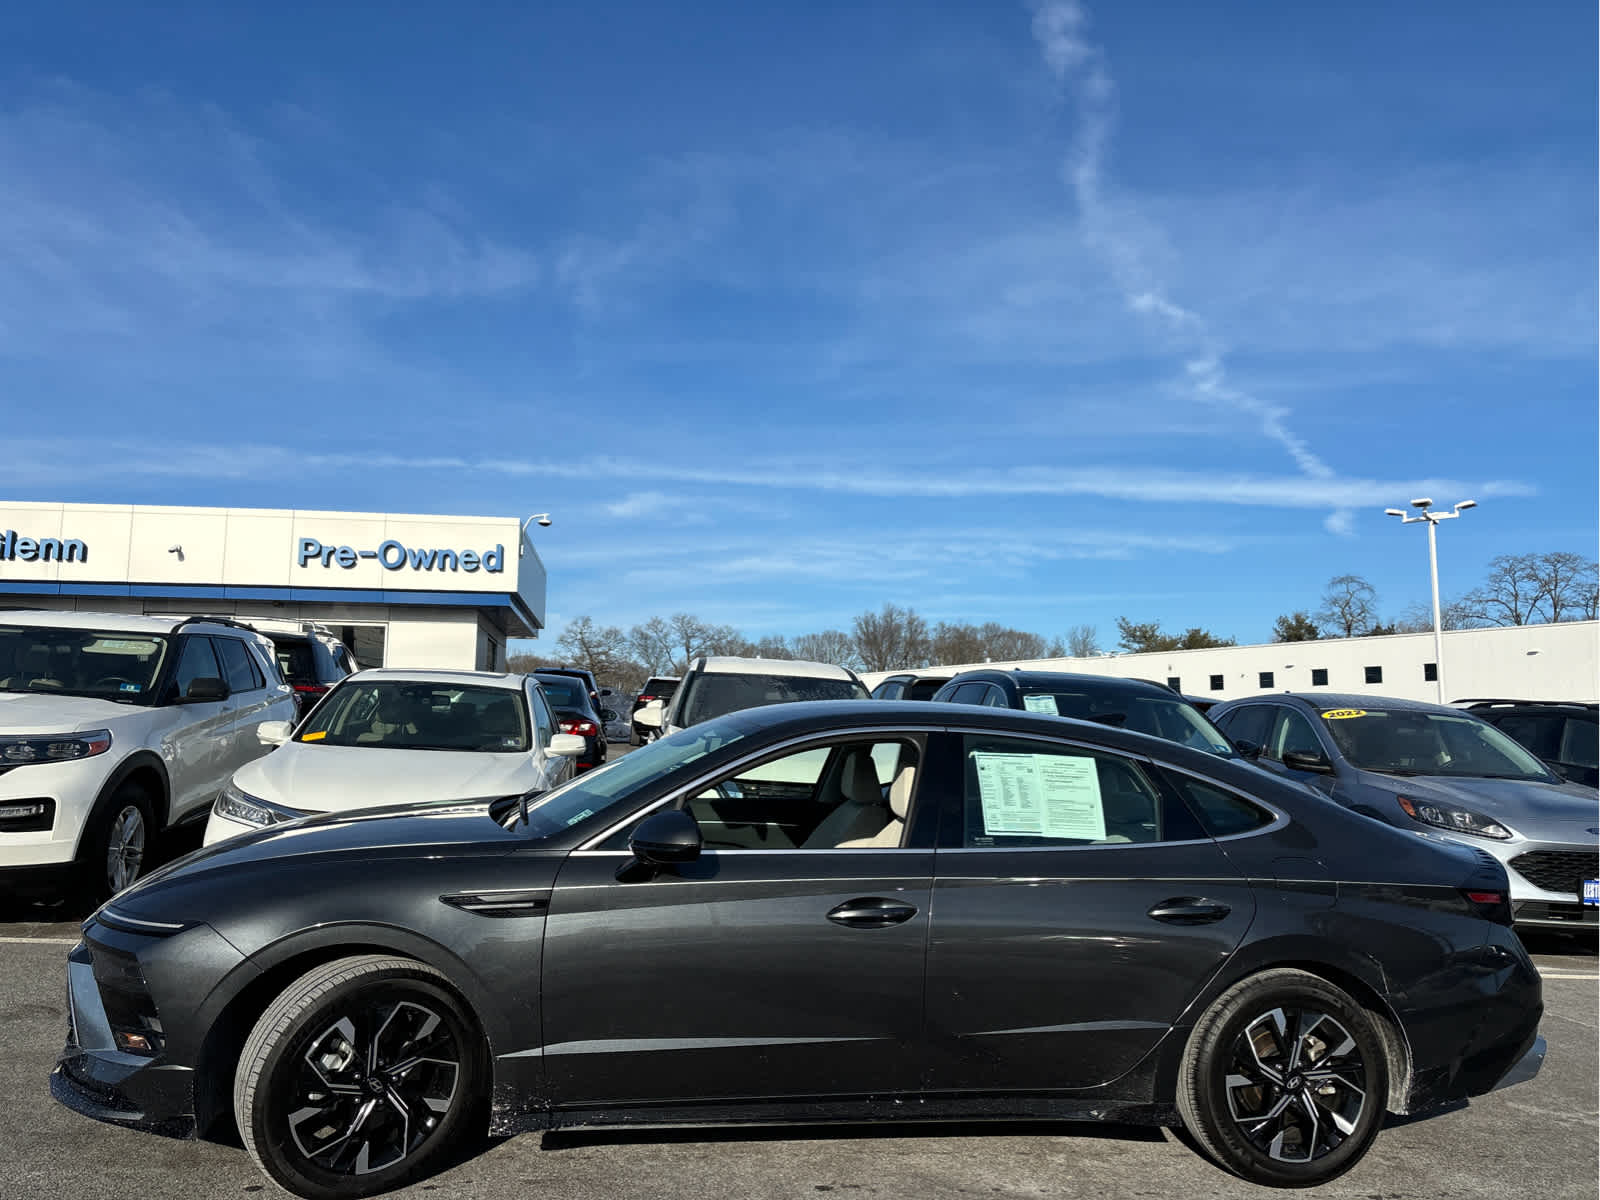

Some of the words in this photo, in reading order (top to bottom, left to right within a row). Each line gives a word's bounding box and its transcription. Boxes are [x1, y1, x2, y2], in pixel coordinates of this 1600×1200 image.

[0, 529, 88, 563] lenn
[298, 537, 504, 573] Pre-Owned
[1327, 709, 1362, 718] 2022
